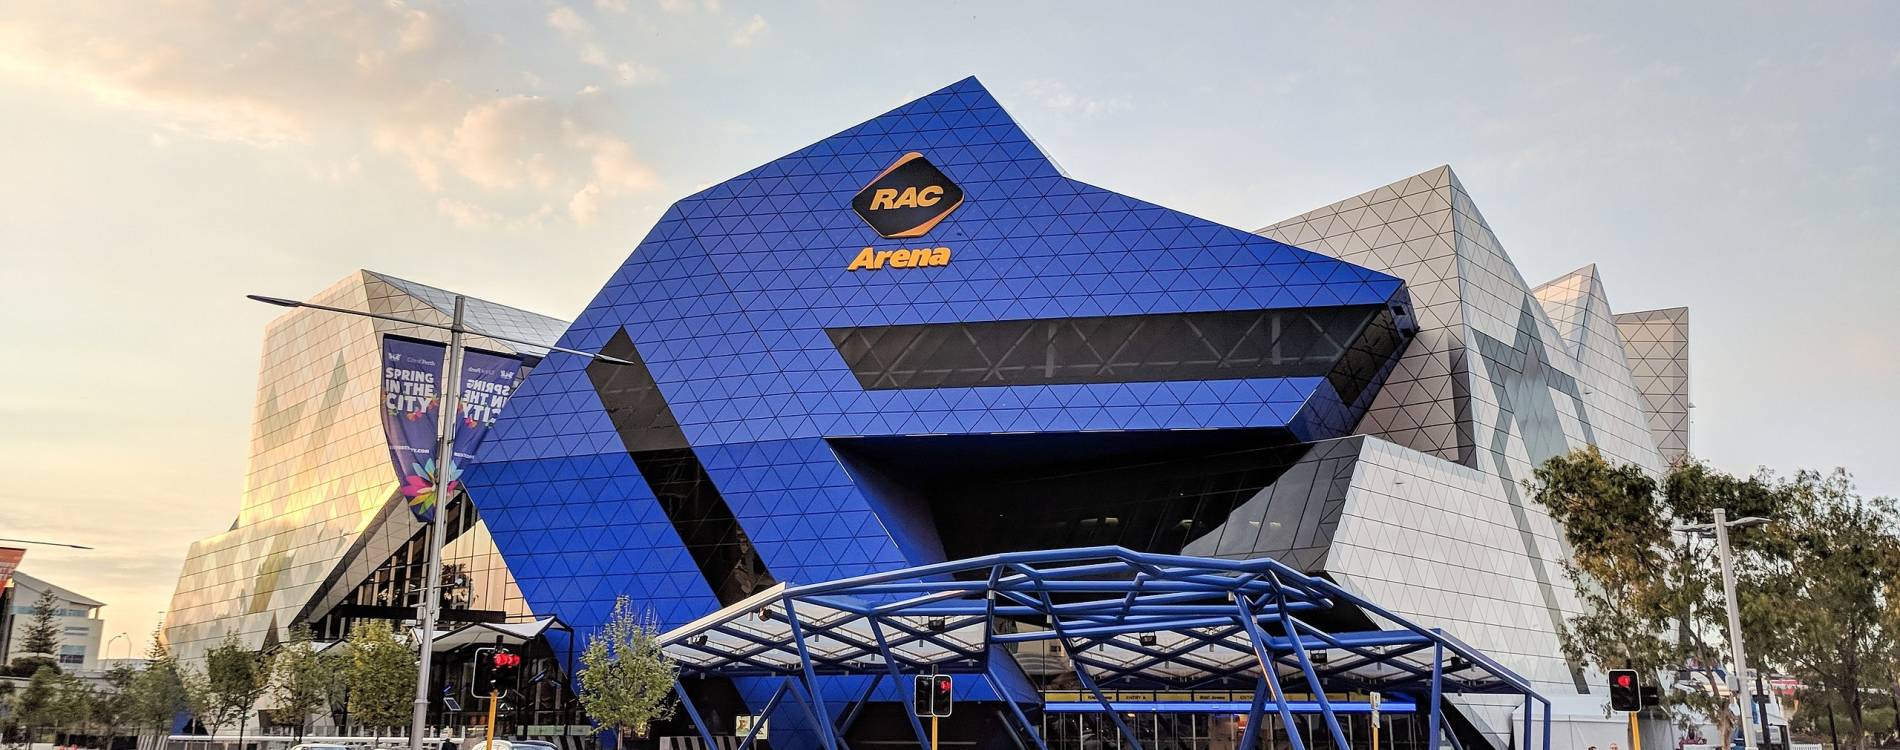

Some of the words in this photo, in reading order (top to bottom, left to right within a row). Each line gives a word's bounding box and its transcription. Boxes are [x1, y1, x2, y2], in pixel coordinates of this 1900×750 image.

[869, 185, 944, 211] RAC
[847, 247, 951, 271] Arena
[385, 367, 434, 383] SPRING
[385, 378, 400, 393] IN
[402, 381, 435, 396] THE
[386, 392, 433, 413] CITY
